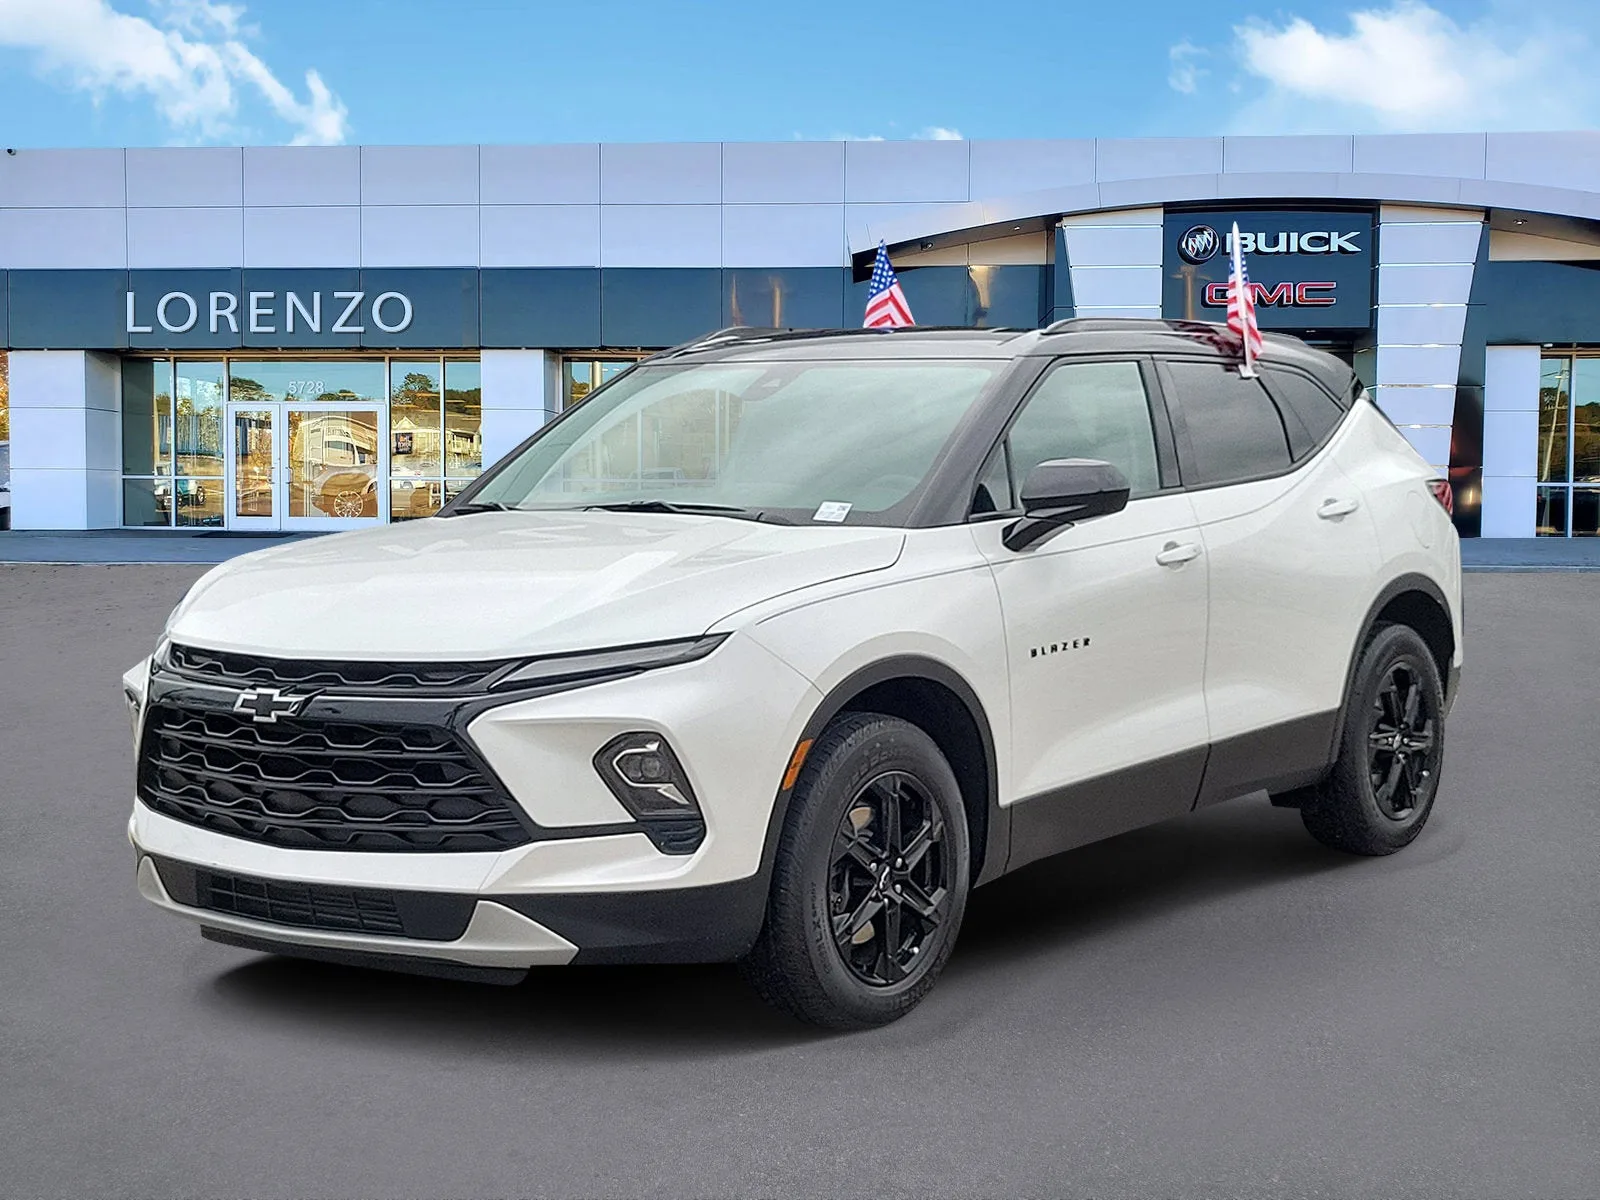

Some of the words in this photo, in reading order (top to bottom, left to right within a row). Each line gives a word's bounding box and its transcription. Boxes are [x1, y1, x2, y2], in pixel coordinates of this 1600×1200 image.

[1226, 231, 1362, 253] BUICK
[1205, 282, 1337, 305] GMC
[125, 291, 414, 334] LORENZO
[288, 380, 325, 395] 5728
[1030, 637, 1091, 658] BLAZER
